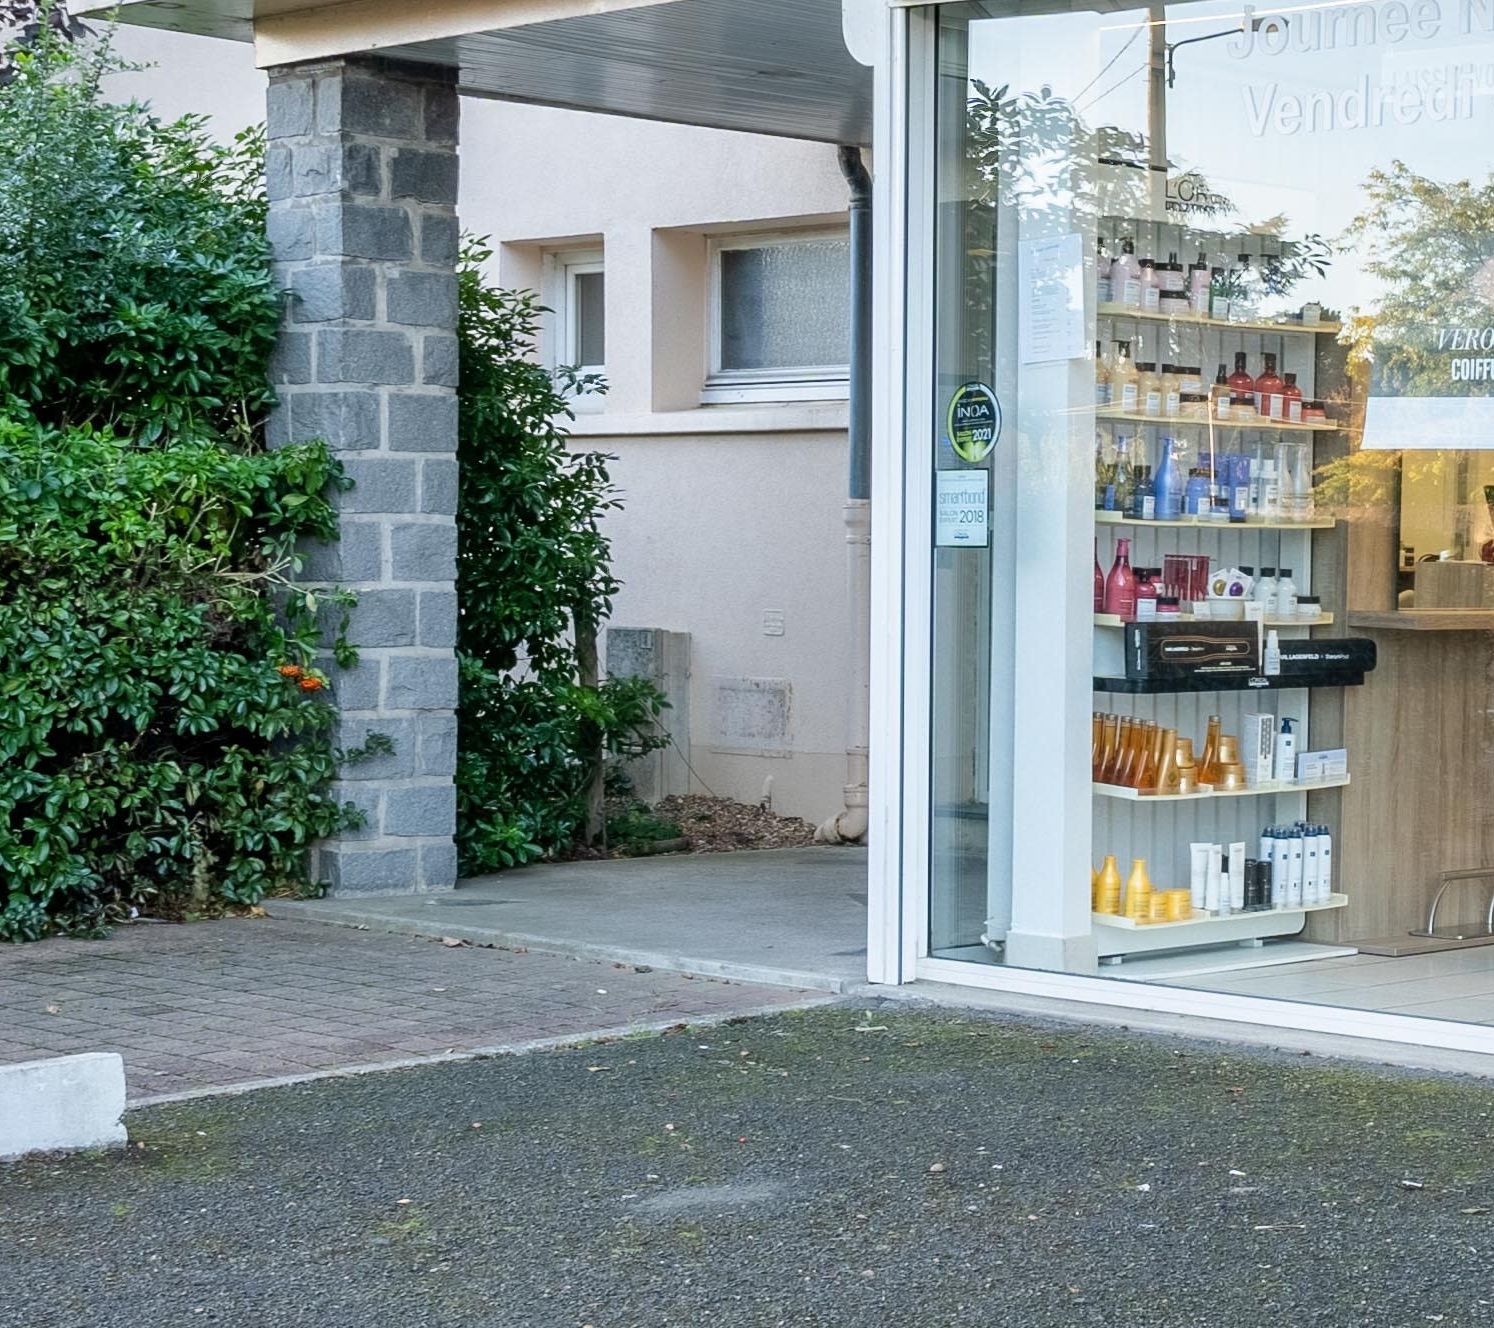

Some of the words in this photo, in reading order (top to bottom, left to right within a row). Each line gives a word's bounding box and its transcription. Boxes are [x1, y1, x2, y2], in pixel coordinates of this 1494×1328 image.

[1240, 63, 1473, 138] Vendredi
[972, 428, 992, 442] 2021
[959, 510, 984, 523] 2018
